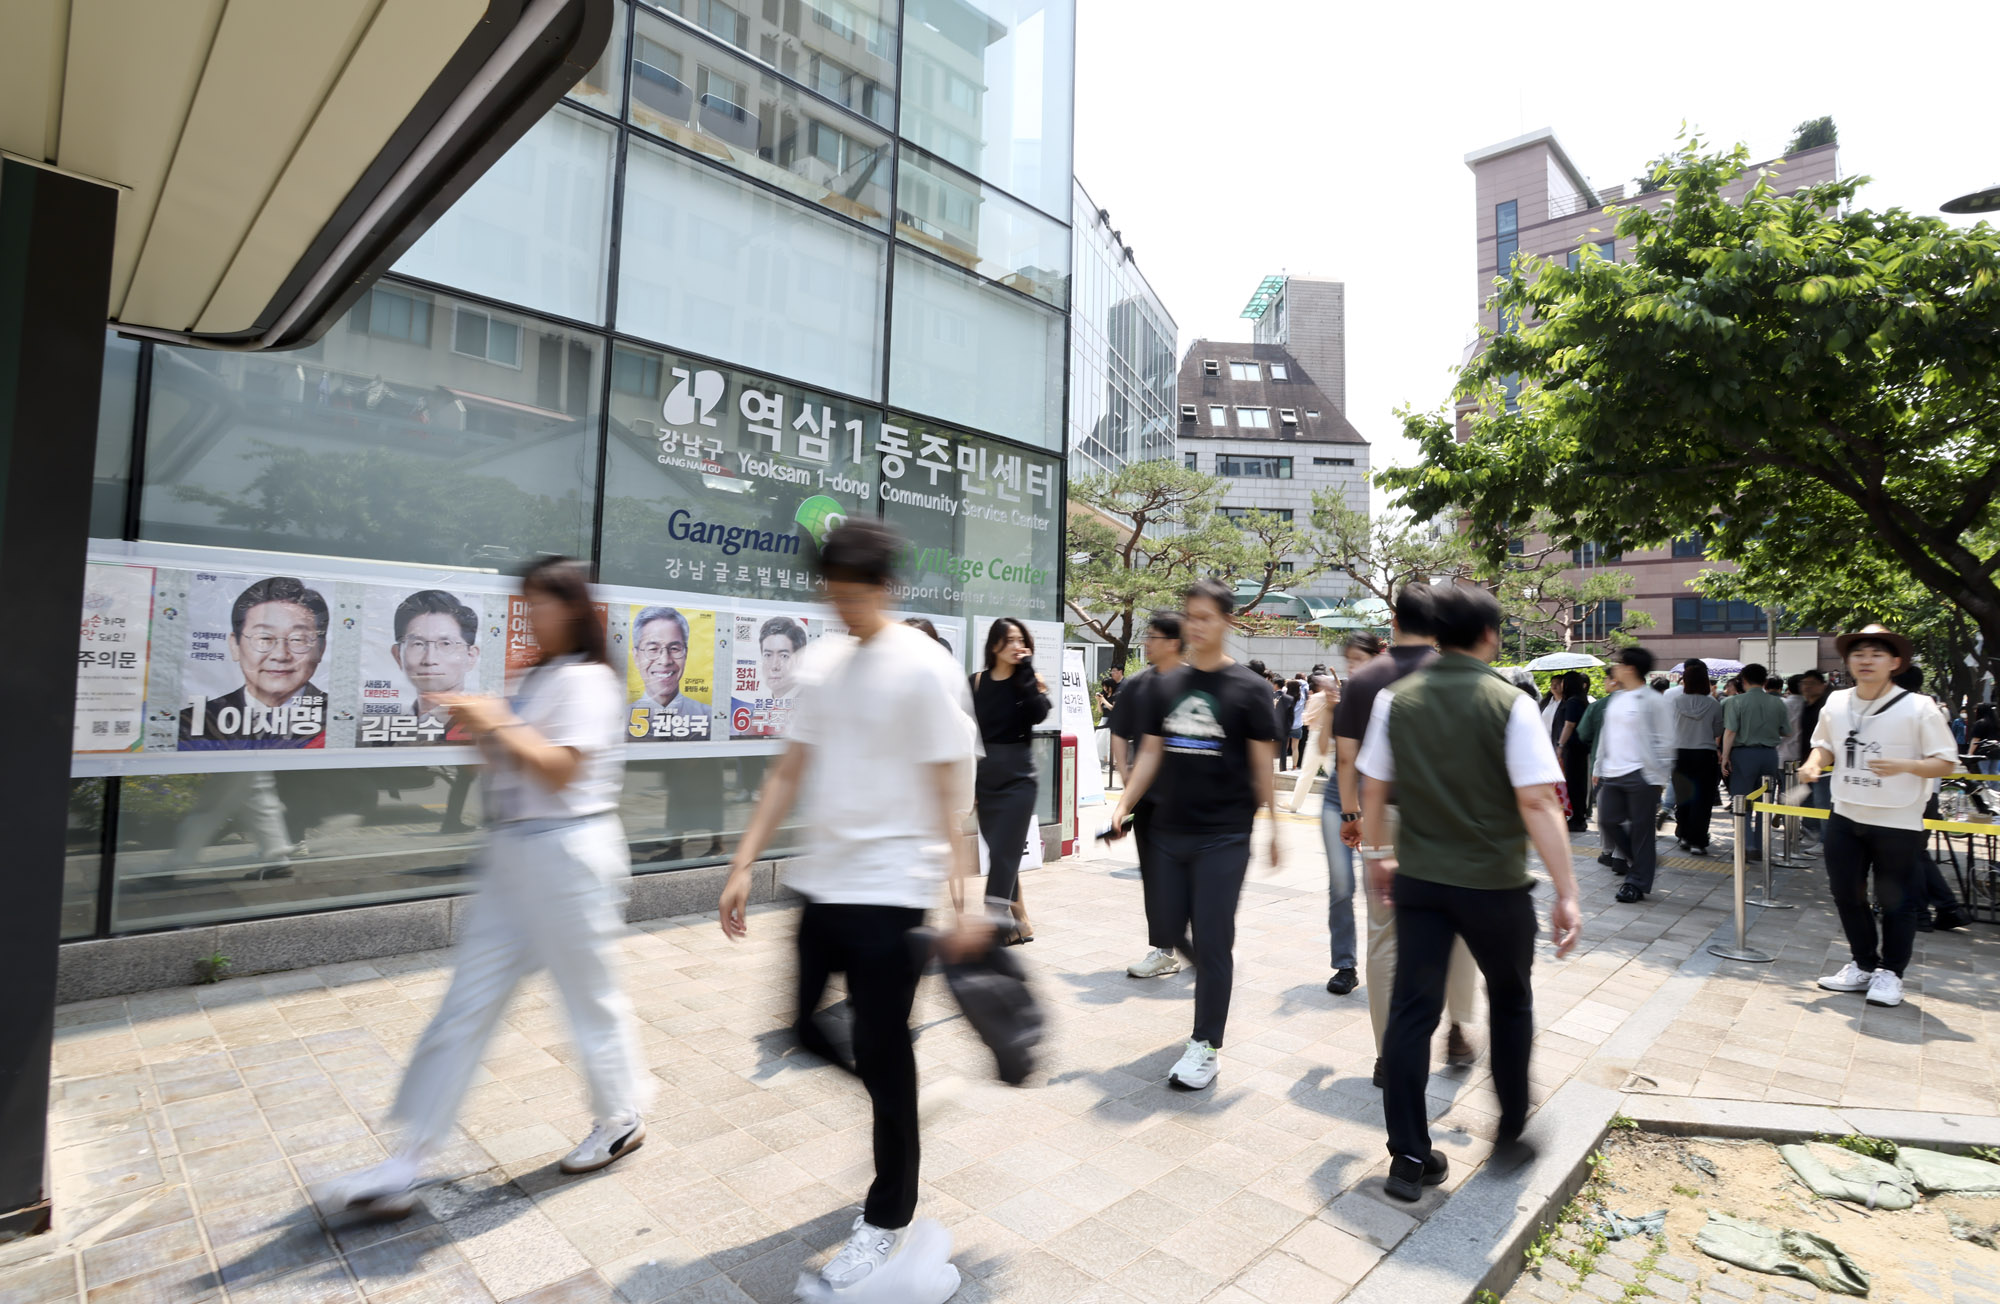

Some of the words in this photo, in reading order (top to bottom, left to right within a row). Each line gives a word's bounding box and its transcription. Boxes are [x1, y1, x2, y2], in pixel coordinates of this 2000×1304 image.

[658, 428, 724, 461] 강남구
[738, 452, 811, 485] Yeoksam
[816, 469, 870, 500] 1-dong
[880, 481, 958, 517] Community
[961, 498, 1008, 523] Service
[1010, 509, 1050, 531] Center
[668, 509, 801, 556] Gangnam
[913, 546, 984, 584] Village
[988, 558, 1049, 586] Center
[884, 580, 939, 600] Support
[943, 588, 985, 604] Center
[192, 631, 227, 641] 이제부터
[191, 641, 209, 651] 진짜
[191, 652, 226, 661] 대한민국
[736, 667, 756, 680] 정치
[364, 680, 392, 689] 새롭게
[735, 680, 760, 692] 교체!
[364, 689, 400, 699] 대한민국
[1064, 693, 1084, 705] 선거인
[291, 695, 324, 706] 지금은
[755, 698, 774, 709] 젊은
[217, 706, 323, 736] 이재명
[628, 707, 650, 738] 5
[652, 714, 709, 737] 권영국
[733, 706, 750, 731] 6
[361, 715, 446, 742] 김문수
